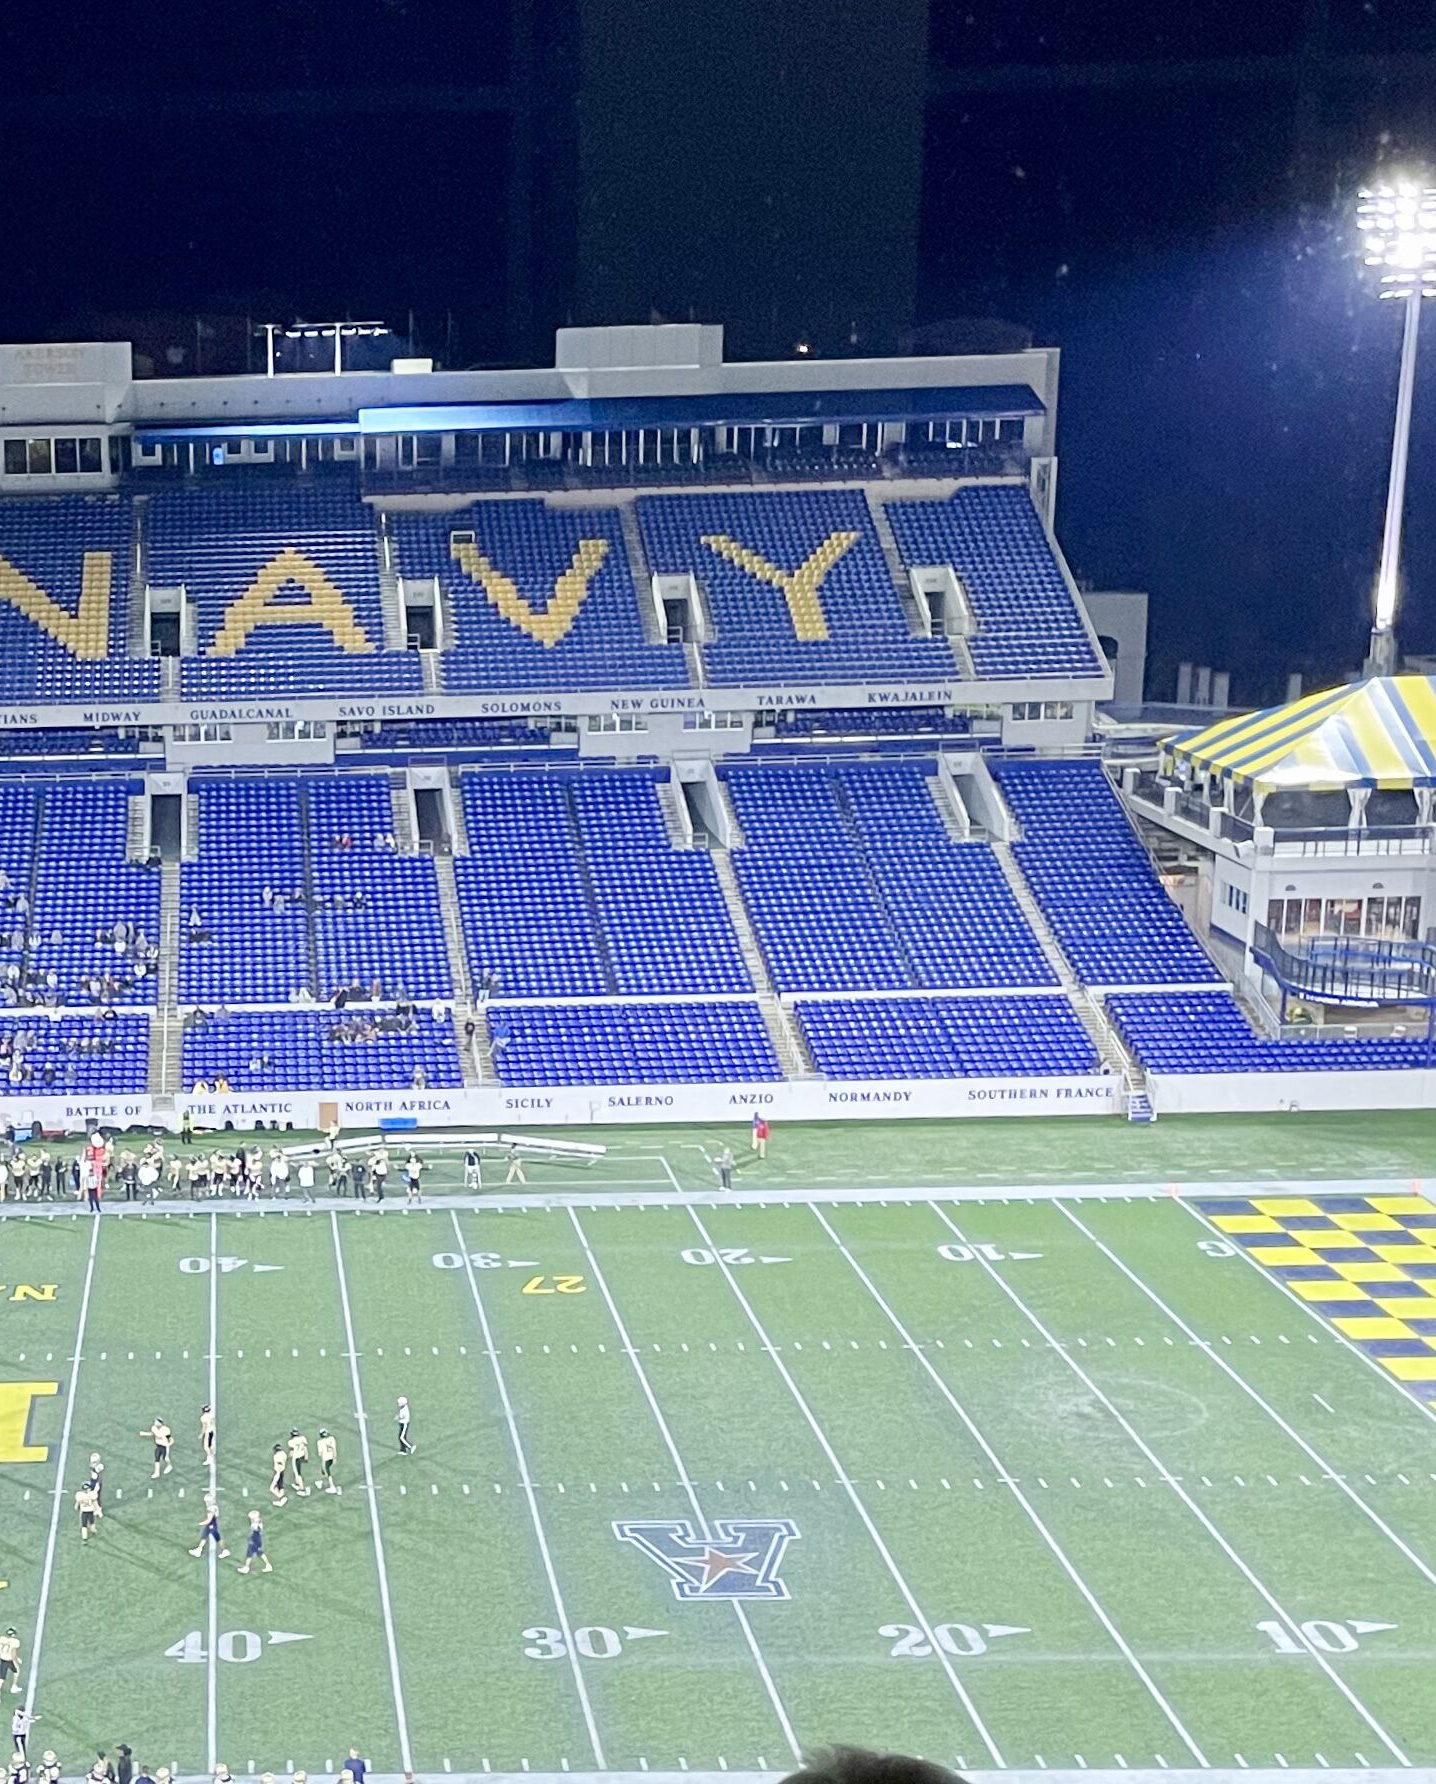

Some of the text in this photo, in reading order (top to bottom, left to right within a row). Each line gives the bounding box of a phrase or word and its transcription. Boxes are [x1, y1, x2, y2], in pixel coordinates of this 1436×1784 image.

[758, 696, 815, 705] TARAWA
[868, 692, 951, 702] KWAJALEIN
[482, 703, 561, 713] SOLOMONS
[612, 699, 704, 709] NEW GUINEA
[190, 709, 293, 720] GUADALCANAL
[340, 705, 434, 717] SAVO ISLAND
[84, 713, 139, 722] MIDWAY
[730, 1094, 773, 1104] ANZIO
[829, 1092, 911, 1102] NORMANDY
[968, 1088, 1112, 1100] SOUTHERN FRANCE
[346, 1101, 450, 1112] NORTH AFRICA
[507, 1099, 552, 1109] SICILY
[609, 1097, 673, 1107] SALERNO
[66, 1107, 142, 1117] BATTLE OF
[188, 1104, 292, 1115] THE ATLANTIC
[877, 1623, 988, 1657] 20
[1255, 1618, 1360, 1654] 10
[164, 1630, 262, 1664] 40
[521, 1626, 623, 1660] 30
